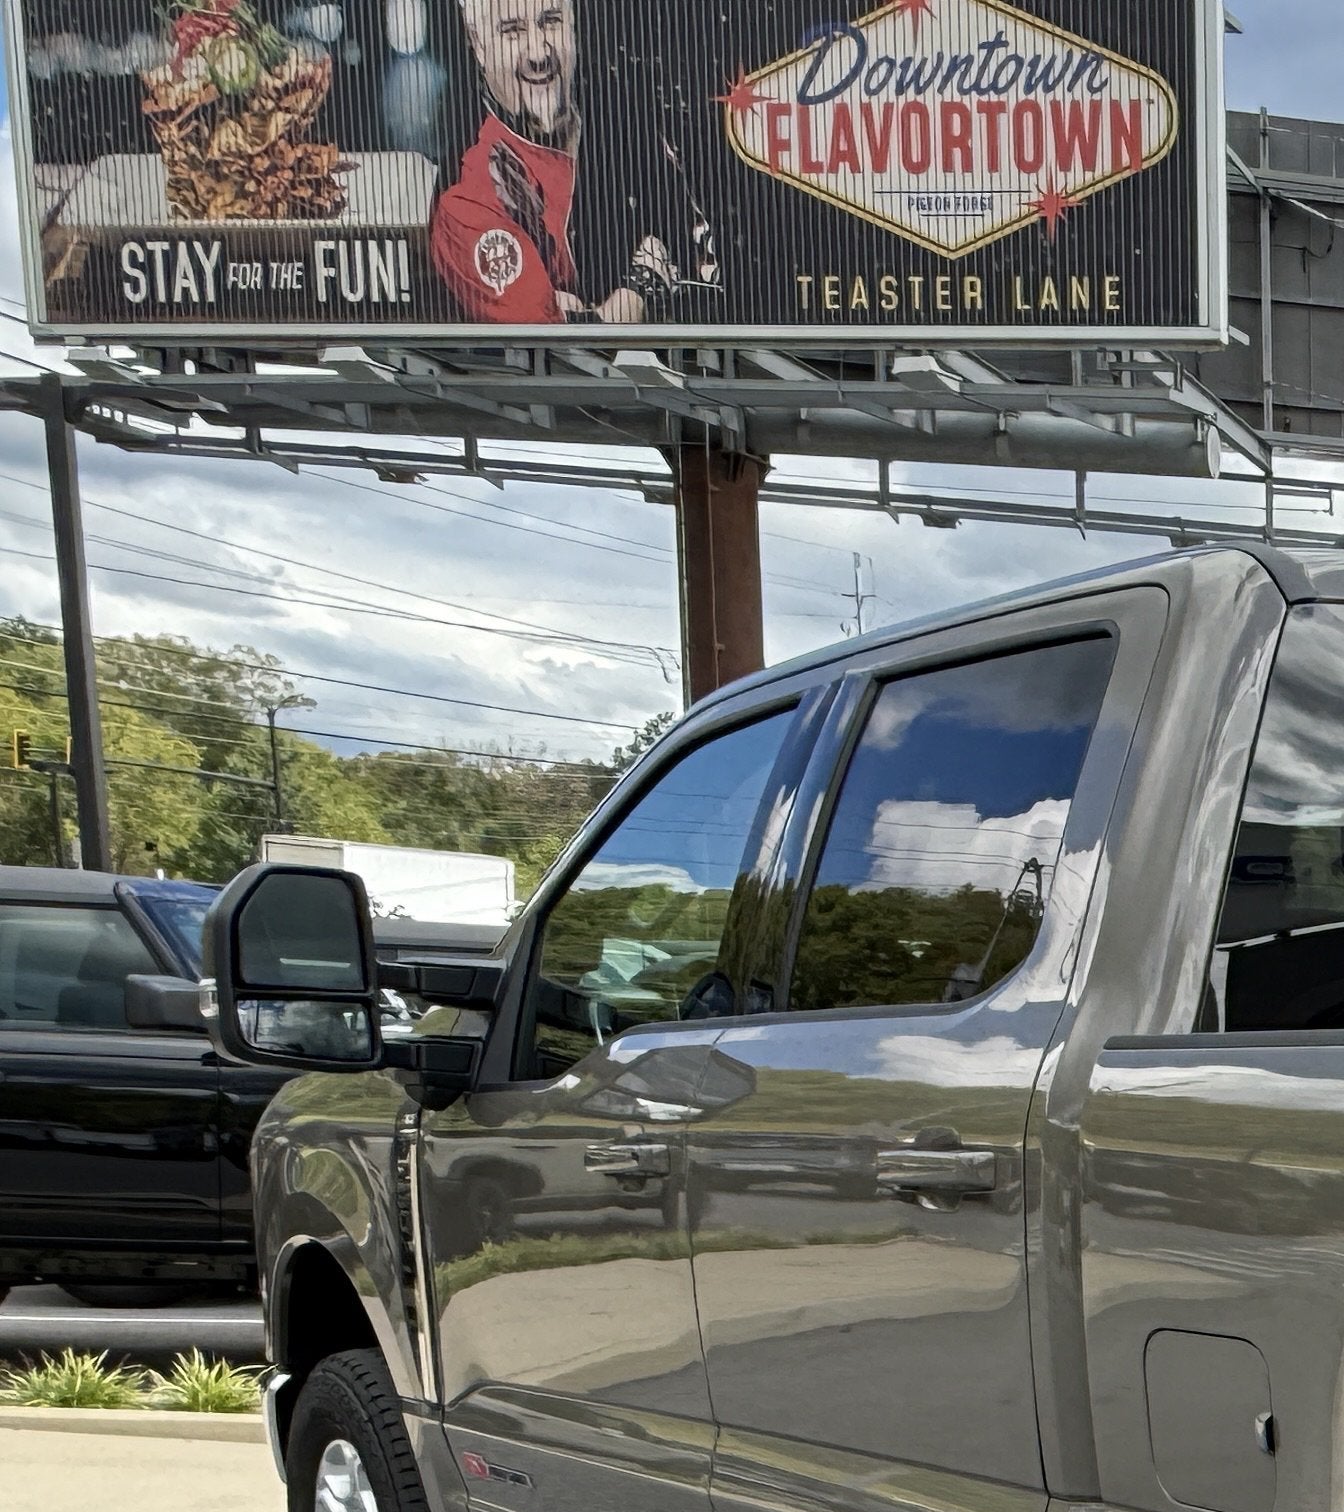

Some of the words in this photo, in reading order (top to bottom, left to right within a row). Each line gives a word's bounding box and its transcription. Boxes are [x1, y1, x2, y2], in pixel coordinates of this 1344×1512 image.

[797, 22, 1109, 105] Downtown
[766, 98, 1143, 174] FLAVORTOWN
[120, 241, 222, 302] STAY
[227, 262, 262, 289] FOR
[269, 261, 304, 289] THE
[314, 240, 411, 302] FUN!
[797, 275, 983, 310] TEASTER
[1015, 275, 1121, 310] LANE
